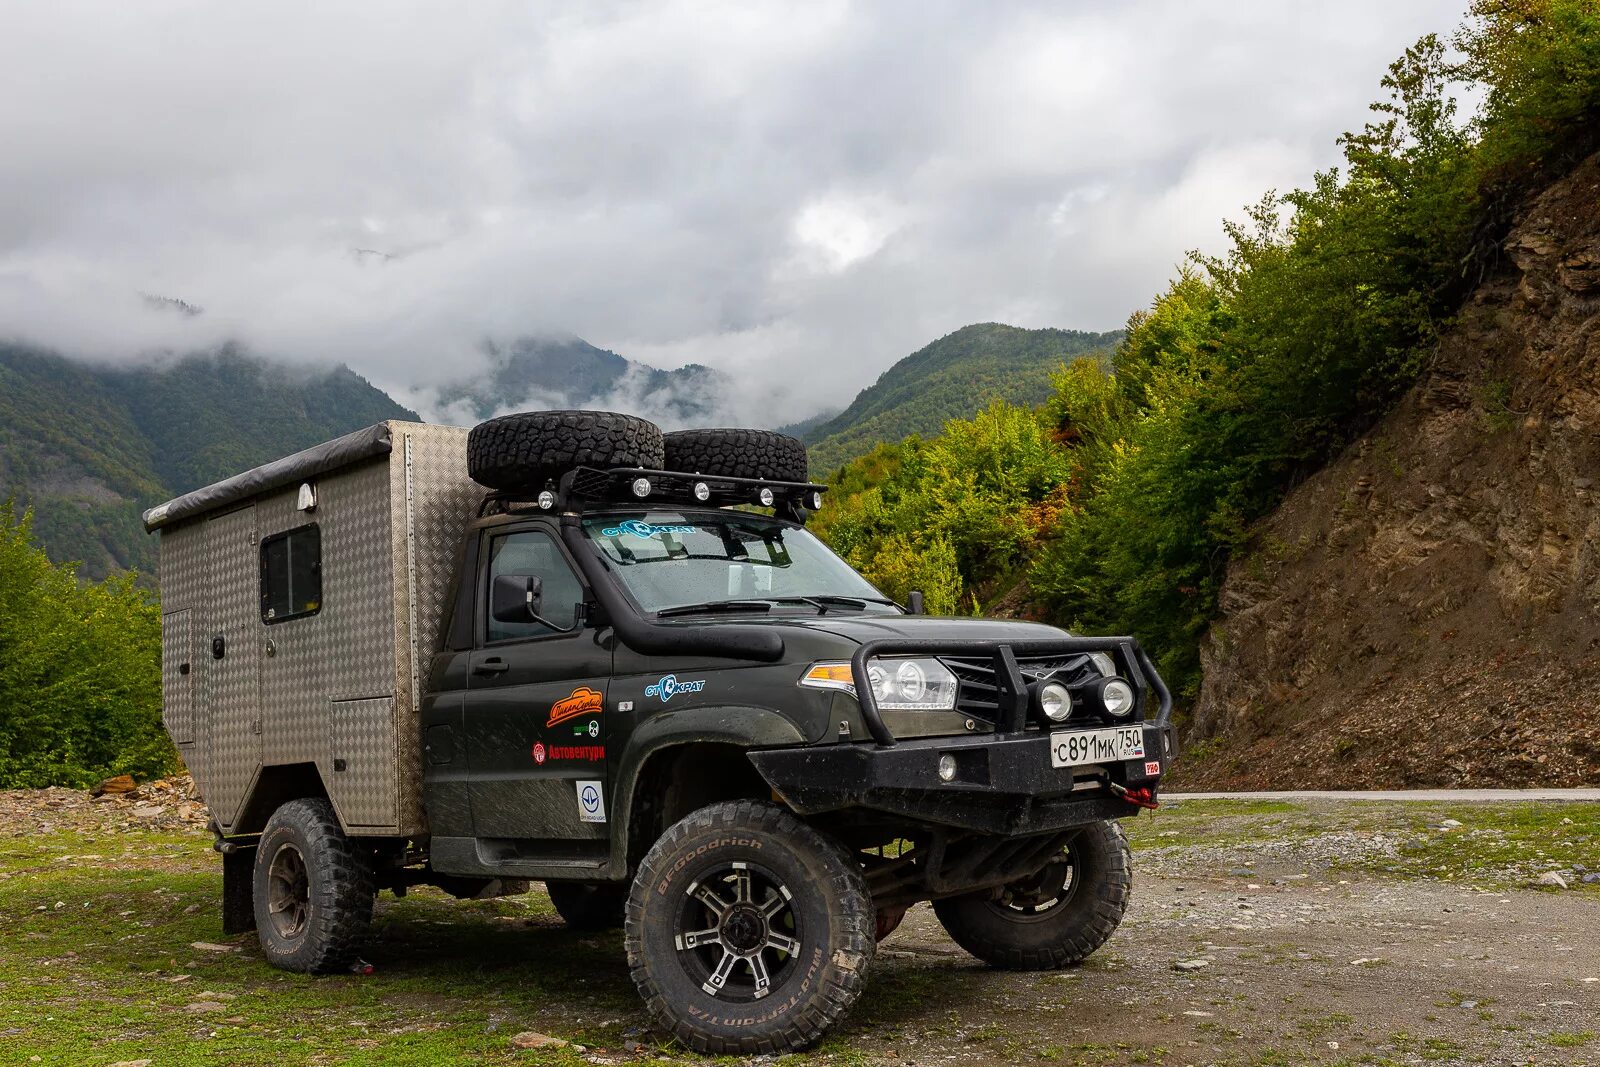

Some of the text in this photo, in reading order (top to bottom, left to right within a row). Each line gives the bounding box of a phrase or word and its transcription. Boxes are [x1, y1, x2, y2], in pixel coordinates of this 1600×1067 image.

[1118, 730, 1140, 749] 750
[548, 744, 605, 761] Автовентури
[1123, 748, 1135, 756] RUS
[657, 836, 763, 895] BFGoodrich
